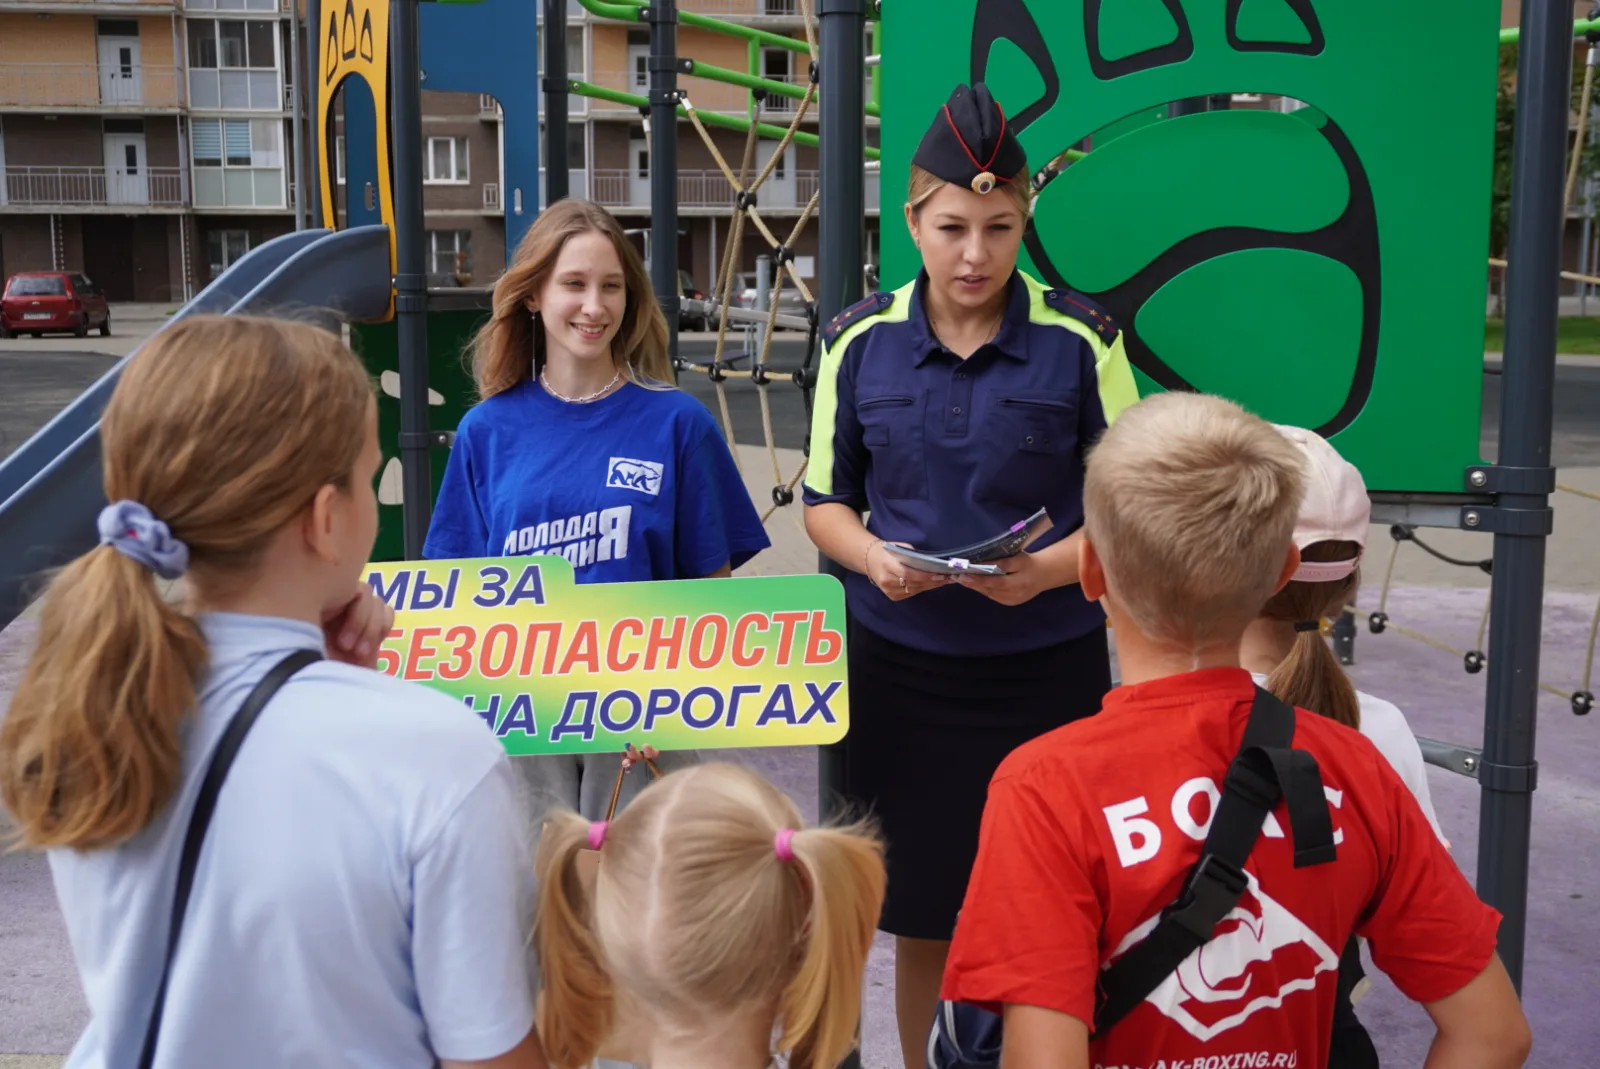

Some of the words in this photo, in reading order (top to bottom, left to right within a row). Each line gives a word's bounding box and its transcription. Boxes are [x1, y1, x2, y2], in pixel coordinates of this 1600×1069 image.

[367, 568, 461, 611] МЫ
[472, 564, 546, 608] ЗА
[377, 610, 843, 681] БЕЗОПАСНОСТЬ
[549, 681, 844, 743] ДОРОГАХ
[1102, 776, 1344, 868] БО
